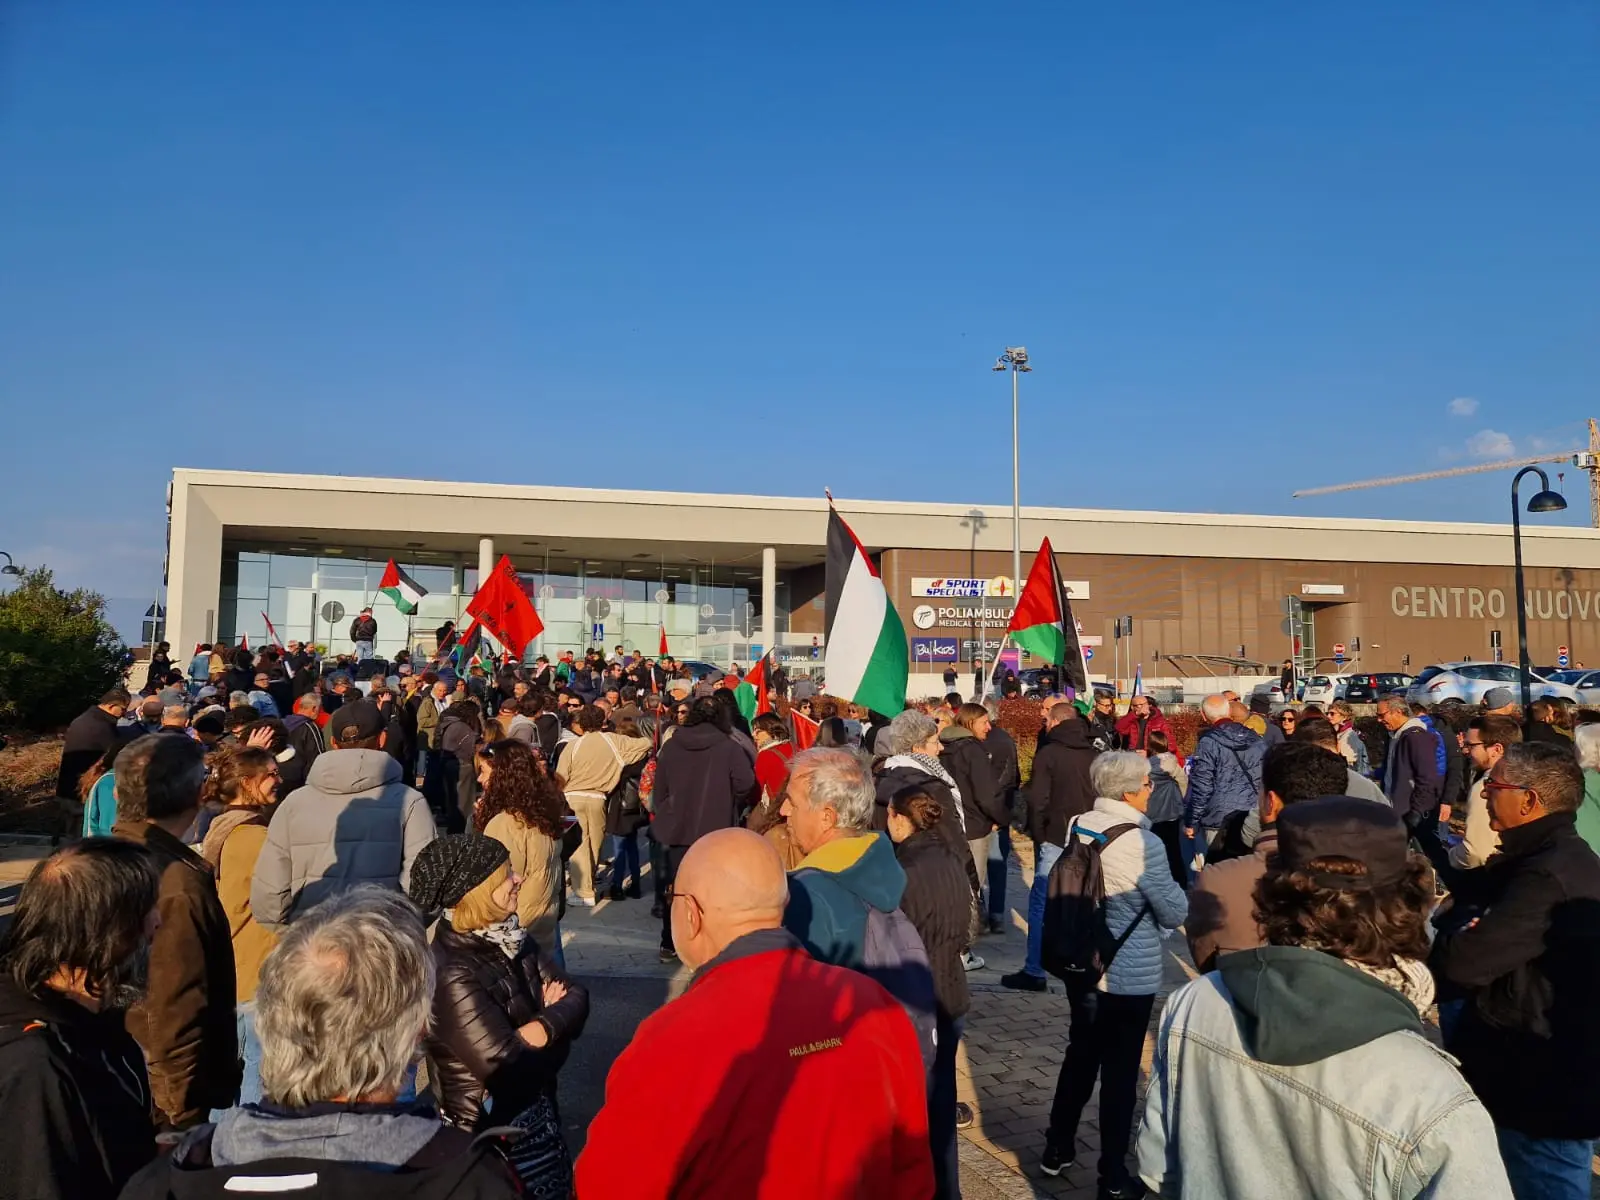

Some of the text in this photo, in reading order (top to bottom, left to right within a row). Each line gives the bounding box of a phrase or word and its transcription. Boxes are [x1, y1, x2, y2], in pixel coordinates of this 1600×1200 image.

[946, 579, 986, 588] SPORT
[926, 588, 985, 597] SPECIALIST
[1391, 586, 1506, 620] CENTRO
[938, 619, 973, 627] MEDICAL
